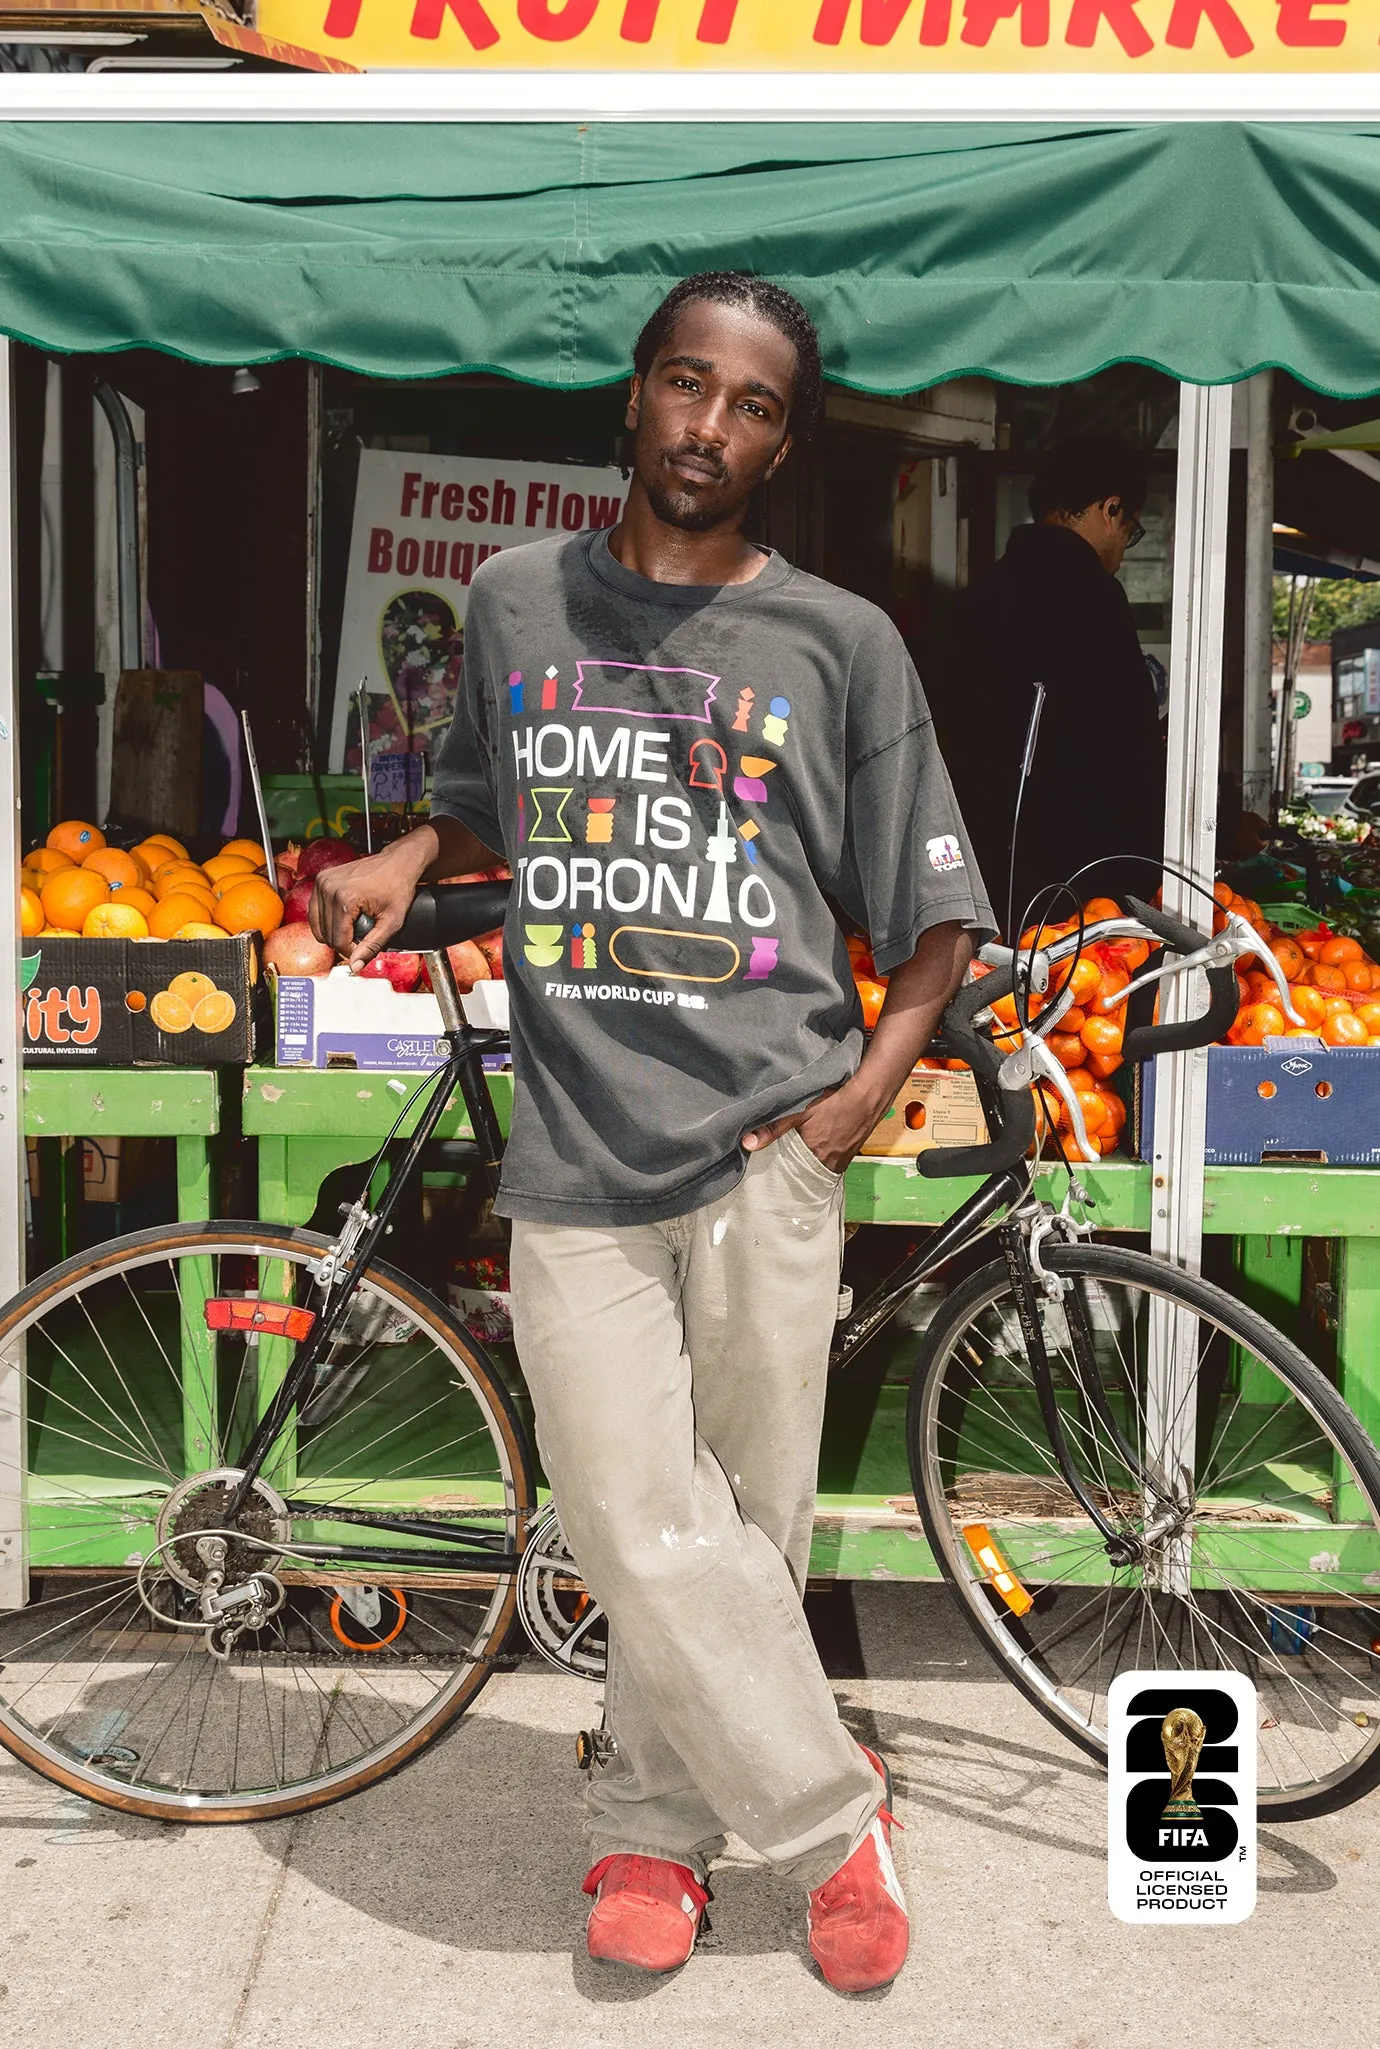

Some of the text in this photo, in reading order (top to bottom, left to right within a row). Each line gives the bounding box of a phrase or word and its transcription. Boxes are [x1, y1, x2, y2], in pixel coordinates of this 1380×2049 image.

[400, 472, 516, 525] Fresh
[367, 528, 502, 586] Bouq
[511, 724, 671, 783] HOME
[635, 793, 692, 850] IS
[22, 985, 102, 1045] ity
[545, 982, 583, 999] FIFA
[584, 985, 641, 1001] WORLD
[642, 989, 676, 1006] CUP
